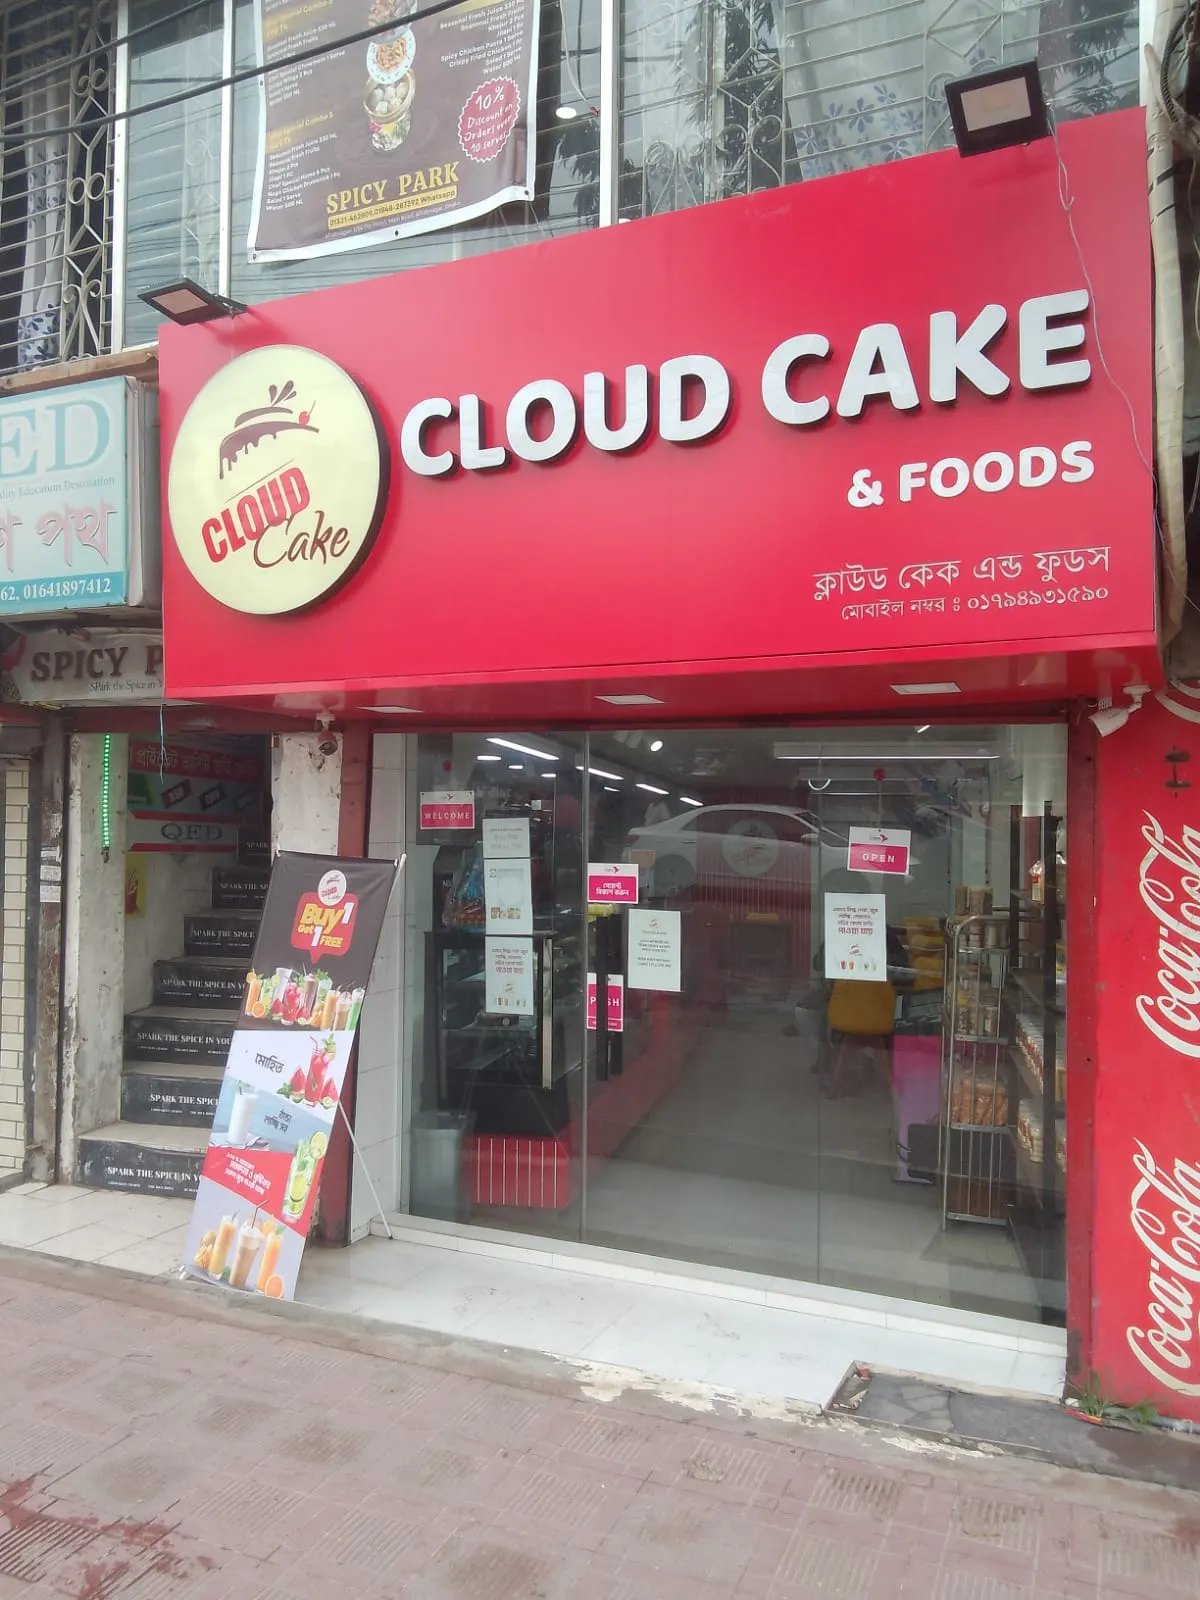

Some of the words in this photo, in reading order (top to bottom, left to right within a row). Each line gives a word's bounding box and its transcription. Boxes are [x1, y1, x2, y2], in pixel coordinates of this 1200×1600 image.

[441, 52, 458, 63] Spicy
[459, 45, 484, 56] Chicken
[476, 86, 504, 110] 10%
[468, 106, 502, 128] Discount
[464, 125, 495, 141] Orders
[326, 179, 388, 214] SPICY
[399, 161, 460, 196] PARK
[400, 354, 731, 476] CLOUD
[761, 288, 1092, 425] CAKE
[847, 468, 884, 508] &
[899, 440, 1095, 502] FOODS
[19, 484, 61, 497] Education
[64, 476, 115, 490] Destination
[202, 467, 310, 563] CLOUD
[253, 510, 350, 568] Cake
[813, 563, 889, 601] ক্লাউড
[899, 560, 961, 590] কেক
[973, 554, 1023, 582] এন্ড
[1033, 546, 1112, 583] ফুডস
[23, 577, 111, 598] 01641897412
[842, 599, 904, 620] মোবাইল
[967, 585, 1108, 610] ০১৭৯৪৯৩১৫৯০
[31, 647, 128, 682] SPICY
[424, 812, 471, 820] WELCOME
[160, 823, 222, 843] QED
[862, 853, 895, 863] OPEN
[341, 902, 354, 924] 1
[193, 929, 216, 937] SPARK
[311, 926, 323, 947] 1
[320, 935, 344, 948] FREE
[204, 980, 226, 989] SPICE
[590, 996, 619, 1006] PSH
[137, 1032, 162, 1041] SPARK
[164, 1033, 179, 1042] THE
[180, 1034, 204, 1044] SPICE
[205, 1036, 214, 1044] IN
[150, 1093, 176, 1103] SPARK
[178, 1096, 195, 1104] THE
[107, 1166, 134, 1176] SPARK
[136, 1168, 153, 1178] THE
[155, 1171, 179, 1180] SPICE
[181, 1172, 191, 1180] IN
